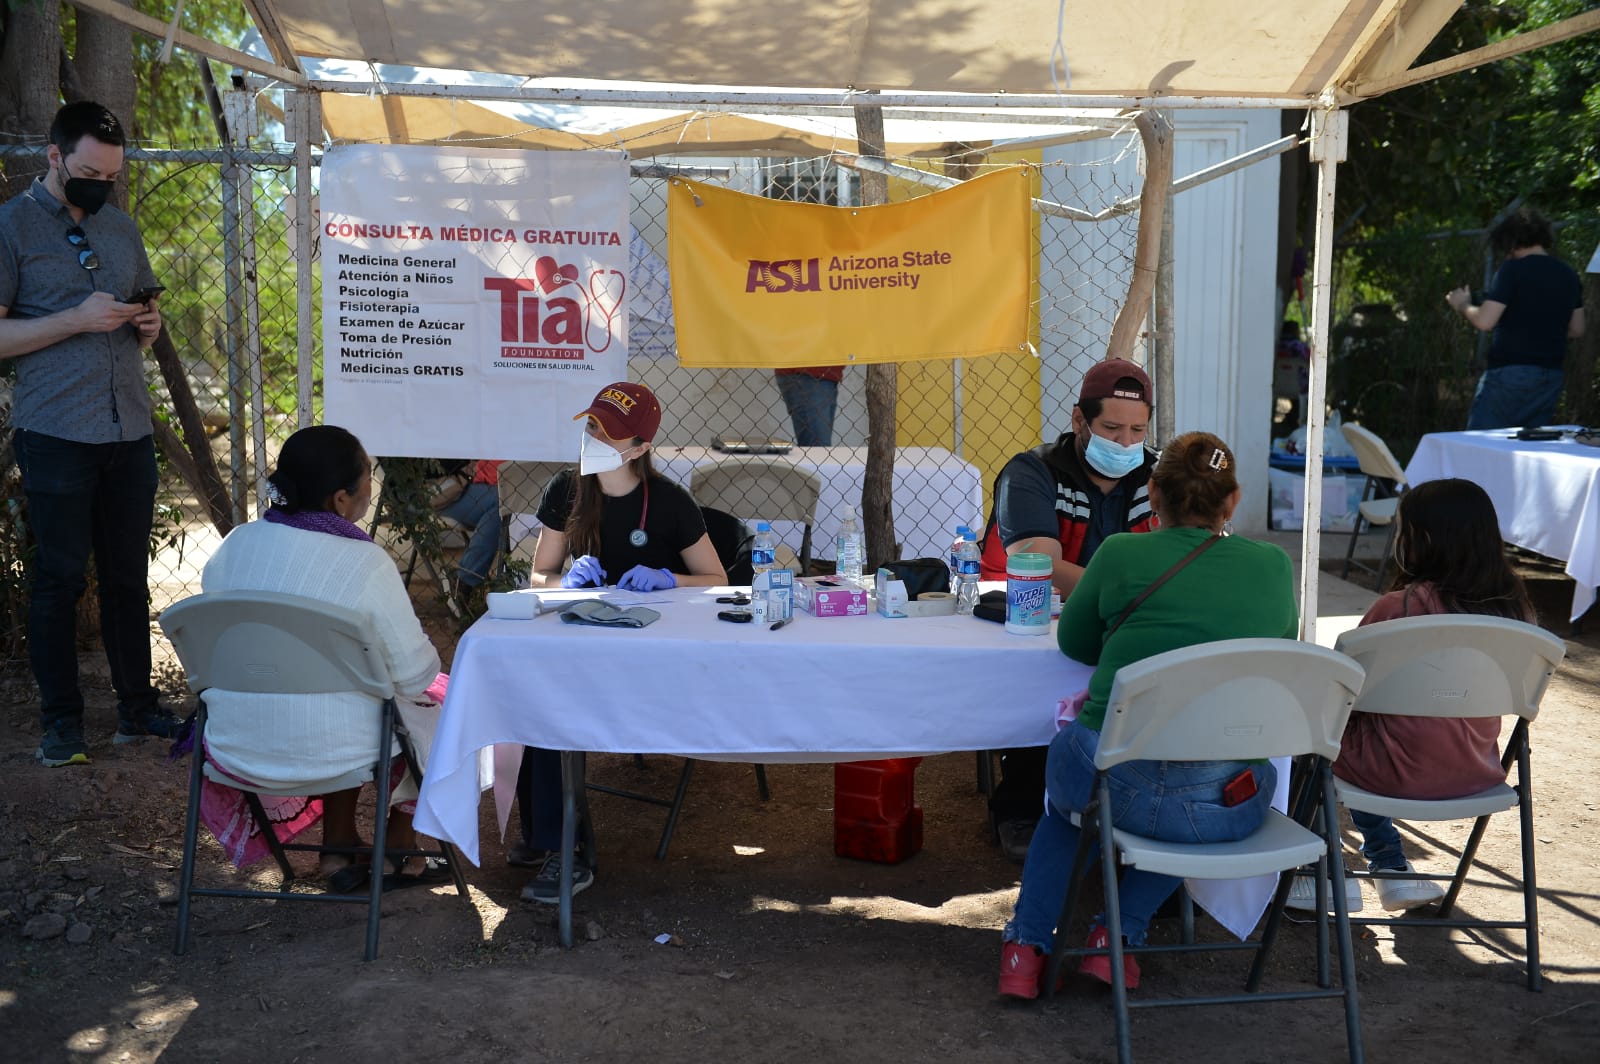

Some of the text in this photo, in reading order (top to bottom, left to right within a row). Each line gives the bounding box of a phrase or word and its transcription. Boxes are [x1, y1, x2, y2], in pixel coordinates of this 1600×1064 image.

[325, 223, 622, 246] CONSULTA MÉDICA GRATUITA
[338, 254, 456, 269] Medicina General
[828, 250, 952, 271] Arizona State
[338, 270, 454, 284] Atención a Niños
[745, 258, 822, 293] ASU
[829, 272, 920, 291] University
[339, 316, 465, 331] Examen de Azúcar
[340, 332, 452, 346] Toma de Presión
[340, 347, 403, 360] Nutrición
[504, 348, 579, 358] FOUNDATION
[341, 363, 464, 377] Medicinas GRATIS
[493, 361, 536, 369] SOLUCIONES
[602, 388, 637, 408] ASU
[1014, 585, 1046, 605] WIPE
